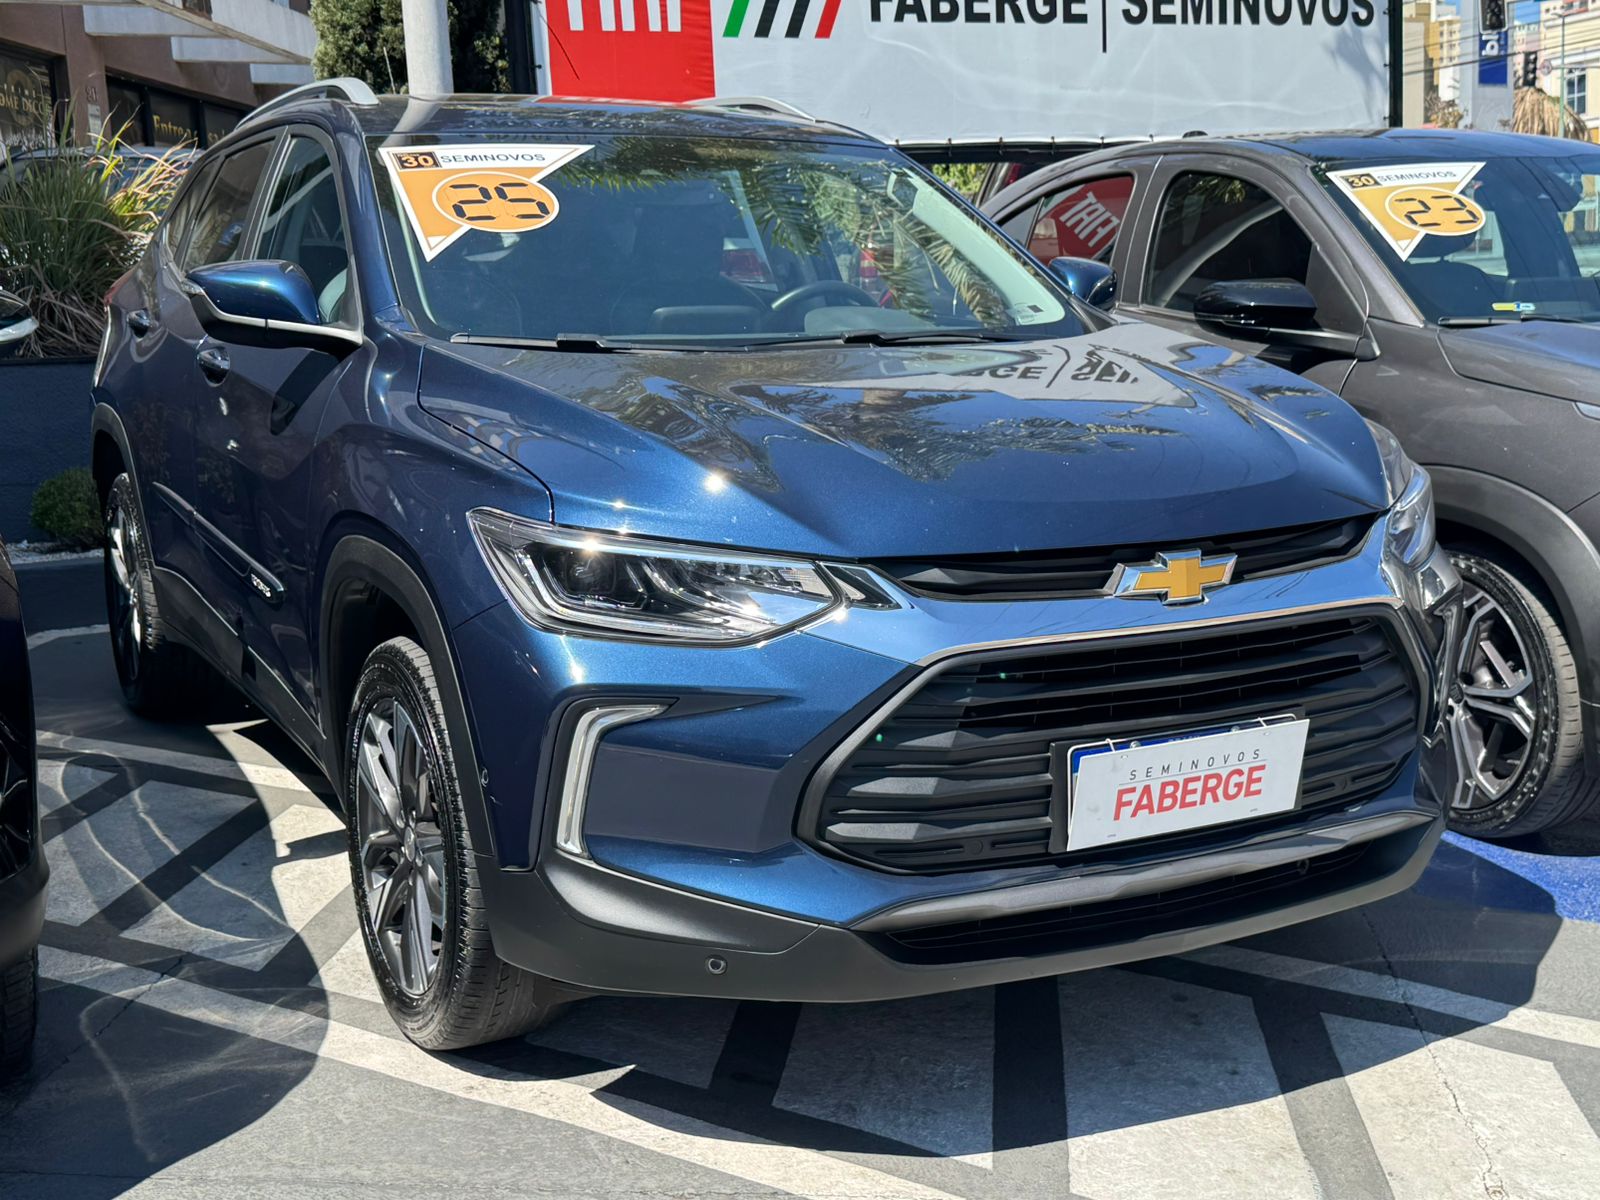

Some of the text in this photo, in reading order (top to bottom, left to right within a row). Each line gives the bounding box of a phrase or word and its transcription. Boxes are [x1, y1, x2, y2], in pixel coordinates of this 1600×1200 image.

[401, 153, 546, 168] 30 SEMINOVOS
[1348, 171, 1457, 187] 30 SEMINOVOS
[449, 183, 551, 221] 25
[1394, 195, 1480, 227] 23
[1129, 749, 1261, 781] SEMINOVOS
[1113, 764, 1267, 821] FABERGE
